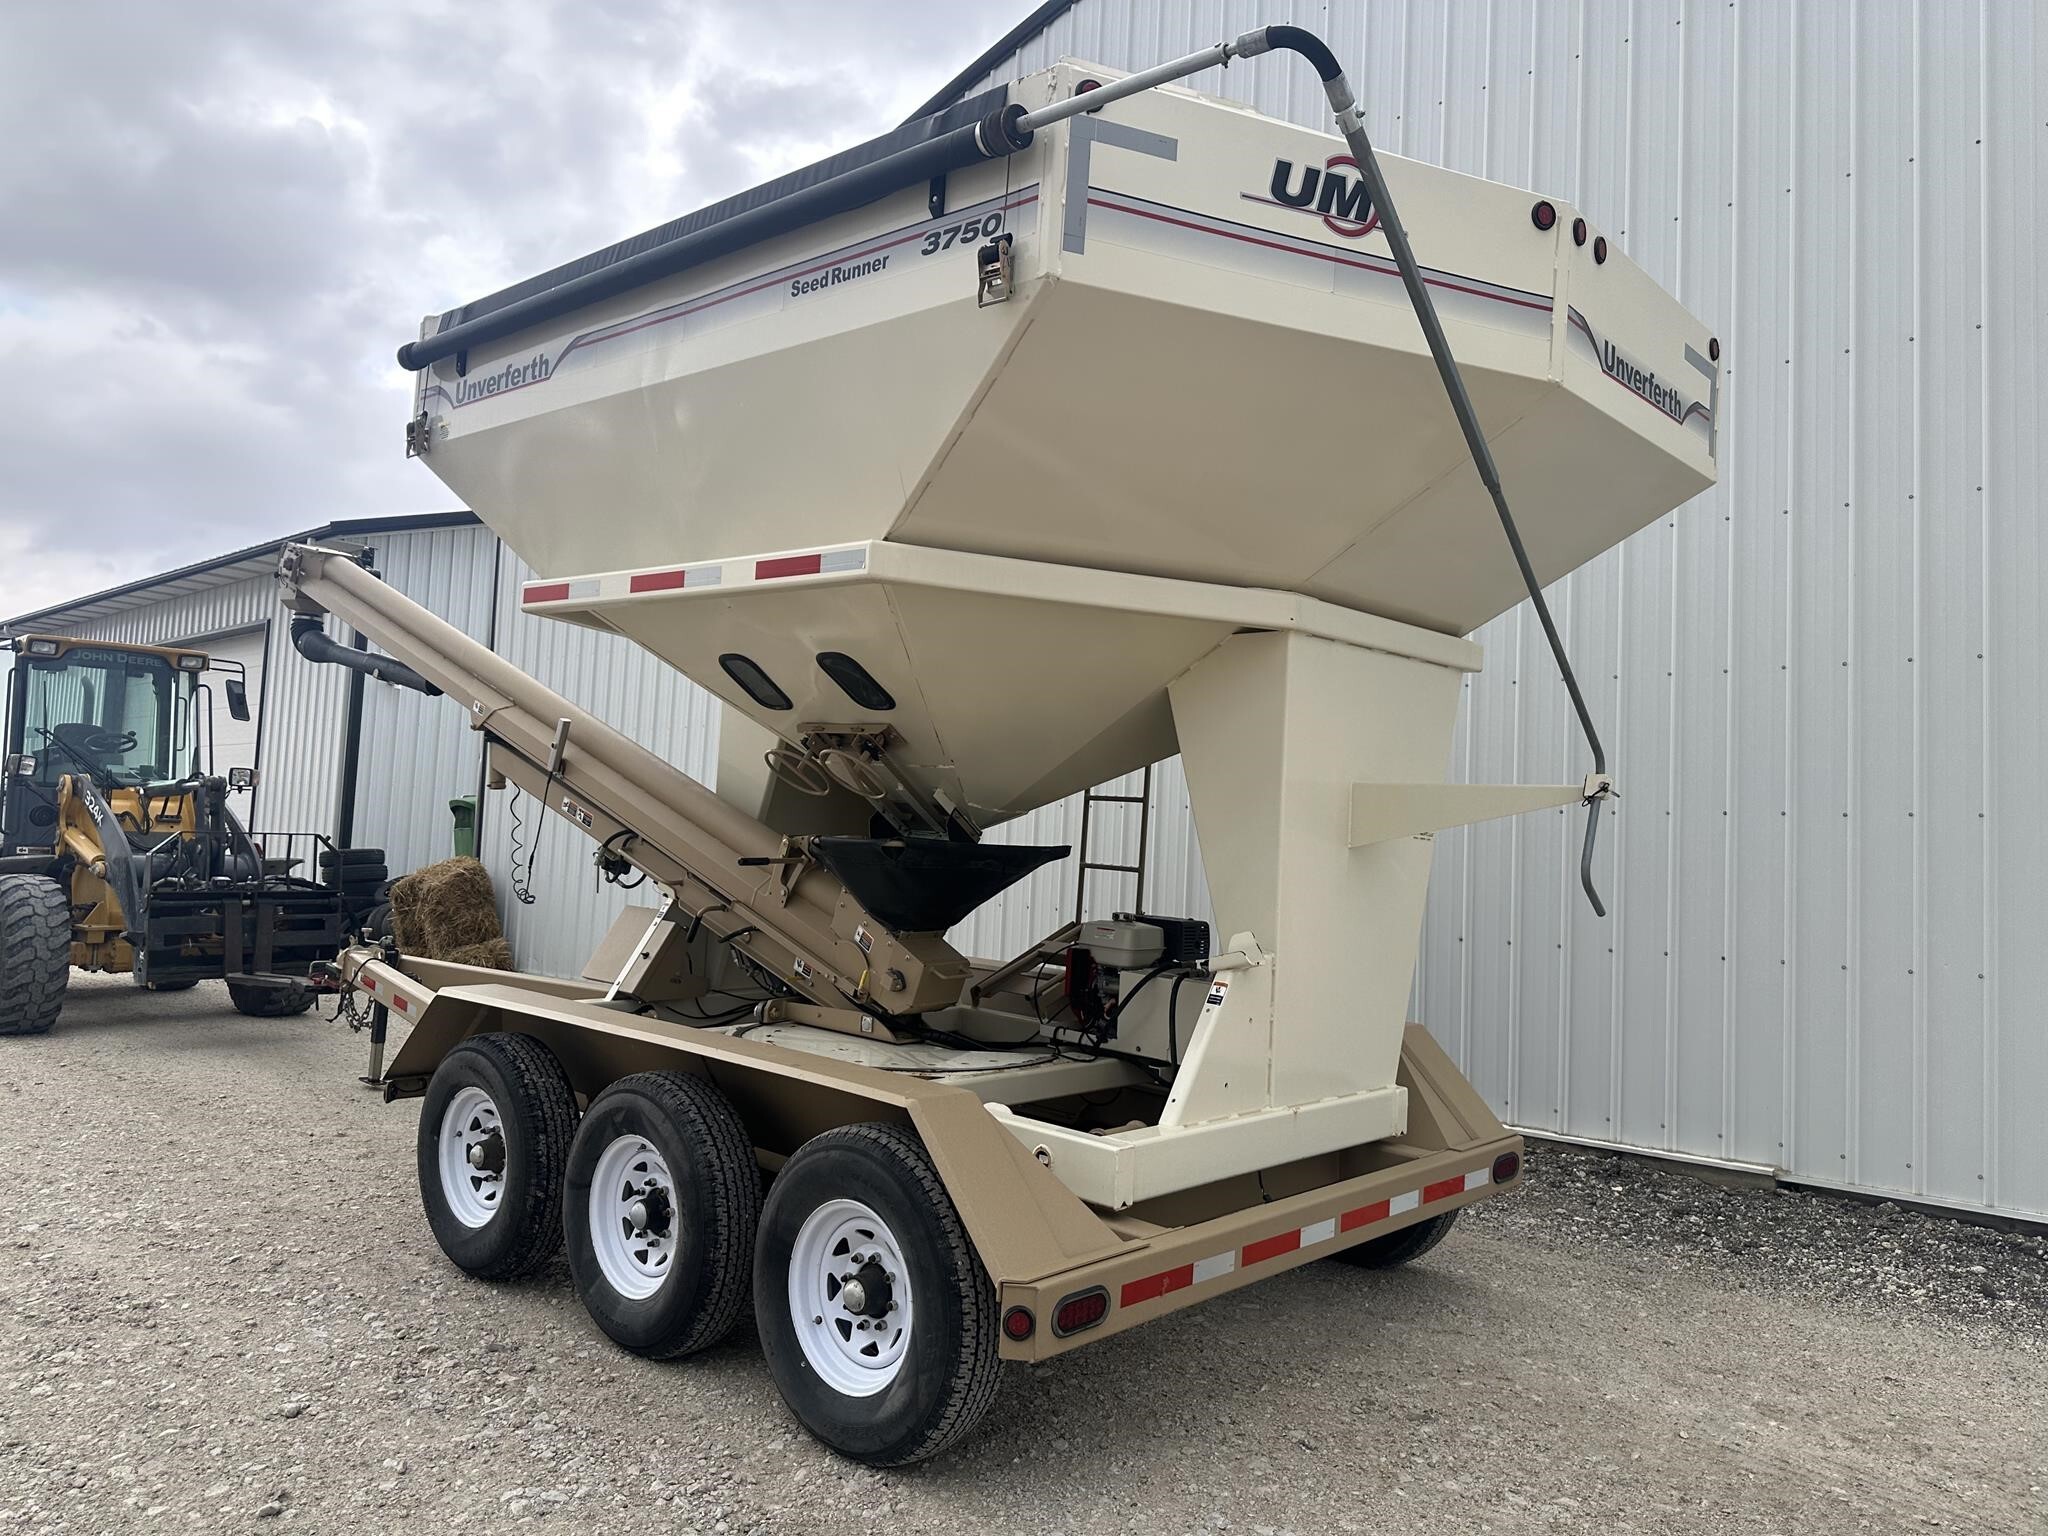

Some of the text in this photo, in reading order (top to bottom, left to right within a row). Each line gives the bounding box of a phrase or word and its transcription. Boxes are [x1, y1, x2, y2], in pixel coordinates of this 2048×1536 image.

[921, 213, 1002, 256] 3750
[455, 353, 550, 404] Unverferth
[1604, 339, 1682, 419] Unverferth
[72, 650, 163, 667] JOHN DEERE
[84, 790, 104, 828] 324K
